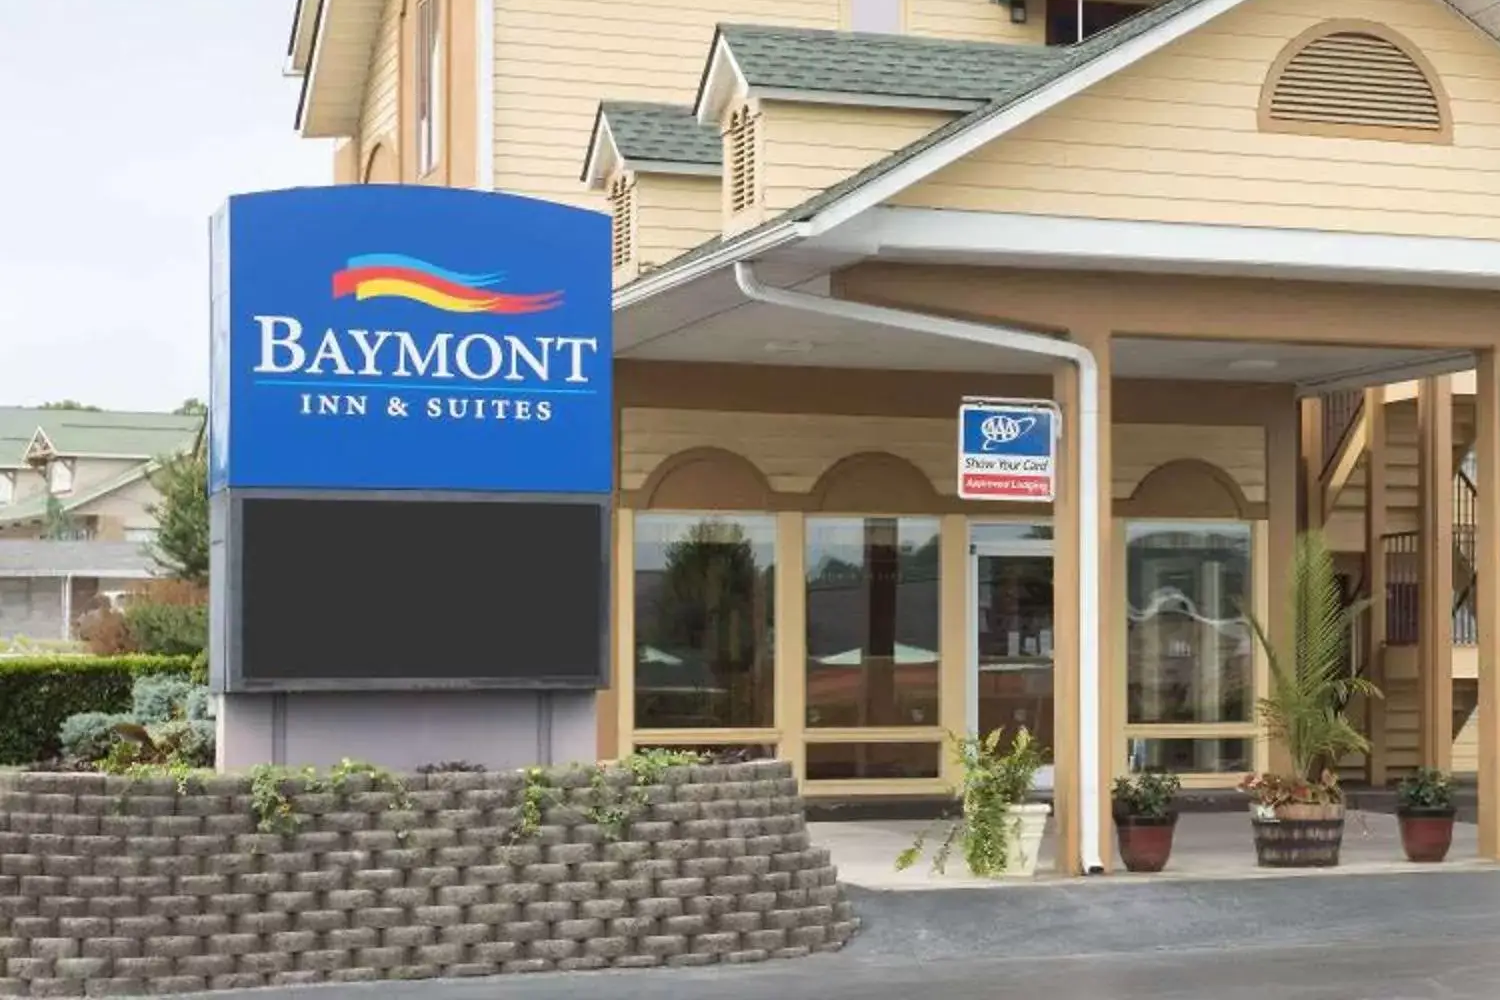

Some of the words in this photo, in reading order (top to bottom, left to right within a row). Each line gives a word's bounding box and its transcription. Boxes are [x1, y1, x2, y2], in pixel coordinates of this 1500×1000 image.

[253, 315, 598, 383] BAYMONT
[301, 393, 368, 416] INN
[387, 396, 408, 416] &
[427, 398, 553, 421] SUITES
[986, 417, 1016, 439] AAA
[965, 457, 996, 469] Show
[999, 458, 1021, 470] Your
[1024, 459, 1048, 471] Card
